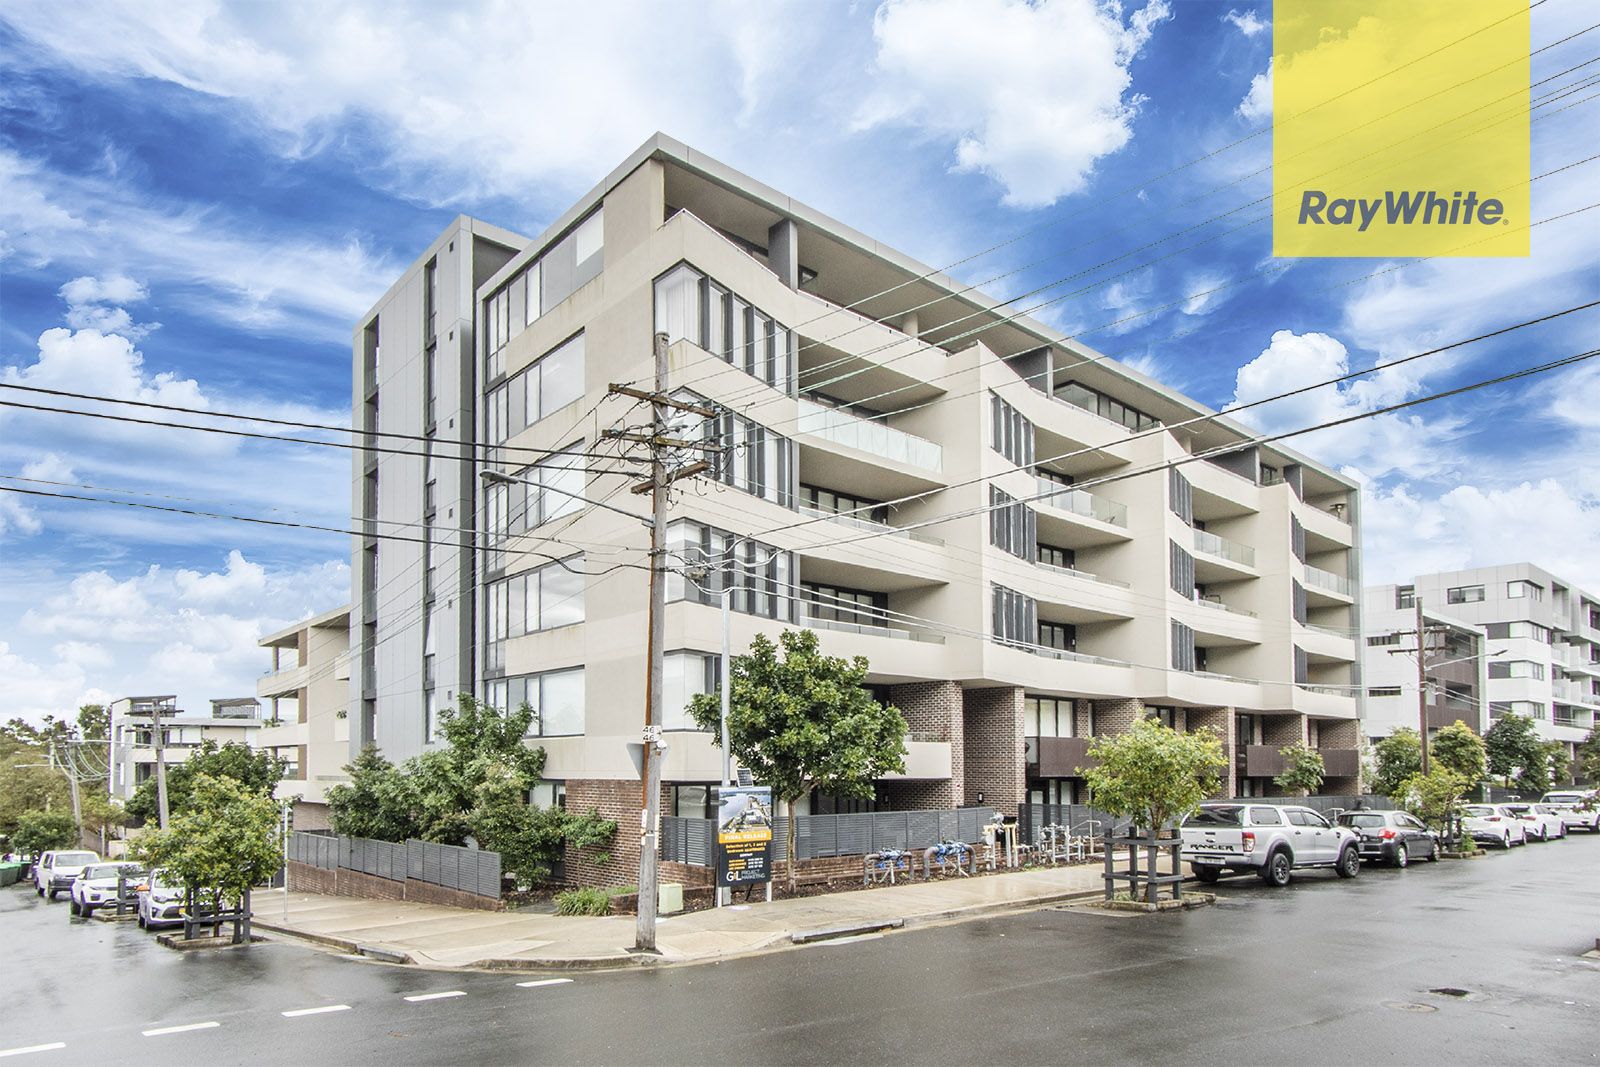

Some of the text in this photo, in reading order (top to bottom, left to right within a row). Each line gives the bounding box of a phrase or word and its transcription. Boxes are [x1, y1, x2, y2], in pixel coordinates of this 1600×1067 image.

[642, 726, 655, 734] 46
[743, 832, 767, 840] RELEASE
[1190, 844, 1234, 852] RANGER
